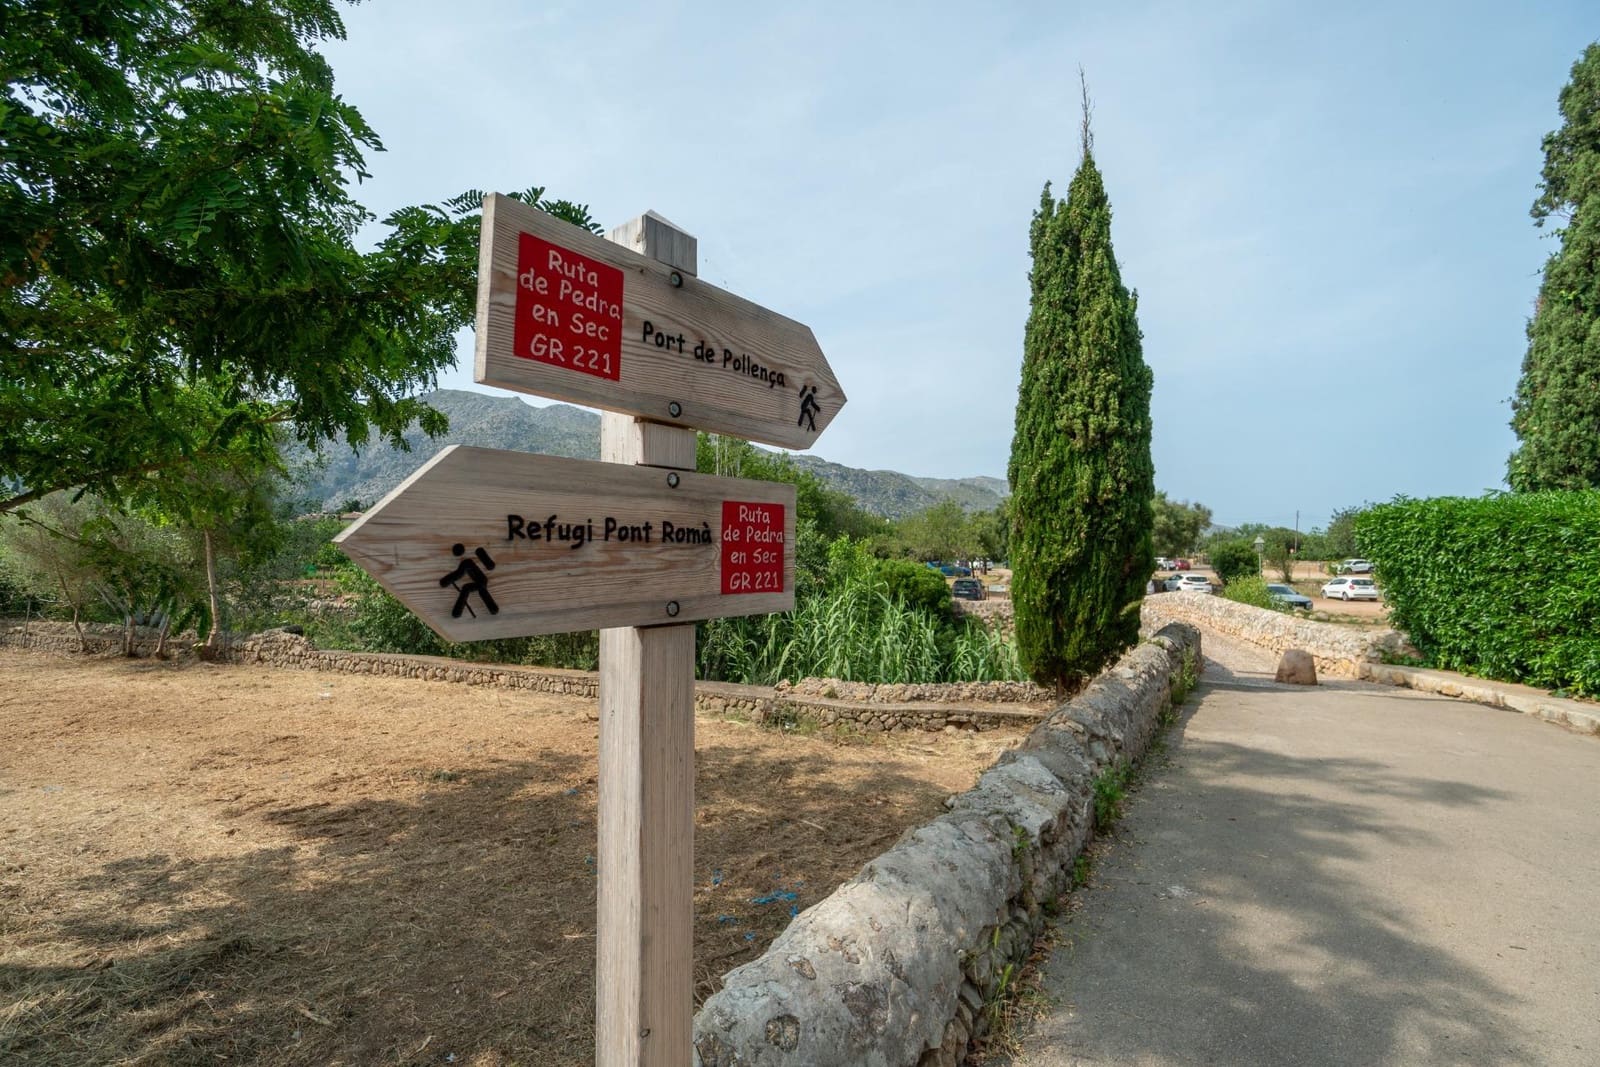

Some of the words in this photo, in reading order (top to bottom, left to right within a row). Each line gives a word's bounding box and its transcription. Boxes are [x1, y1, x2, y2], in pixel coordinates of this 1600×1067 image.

[548, 249, 599, 288] Ruta
[520, 268, 549, 295] de
[559, 278, 621, 320] Pedra
[532, 302, 559, 327] en
[570, 313, 609, 342] Sec
[530, 333, 566, 363] GR
[572, 345, 612, 374] 221
[642, 321, 686, 354] Port
[694, 340, 715, 363] de
[723, 349, 786, 389] Pollença
[507, 514, 593, 549] Refugi
[604, 517, 653, 543] Pont
[661, 521, 713, 545] Romà
[739, 505, 770, 523] Ruta
[723, 525, 740, 542] de
[746, 526, 784, 543] Pedra
[730, 551, 746, 564] en
[753, 548, 777, 564] Sec
[730, 573, 751, 590] GR
[755, 571, 779, 590] 221
